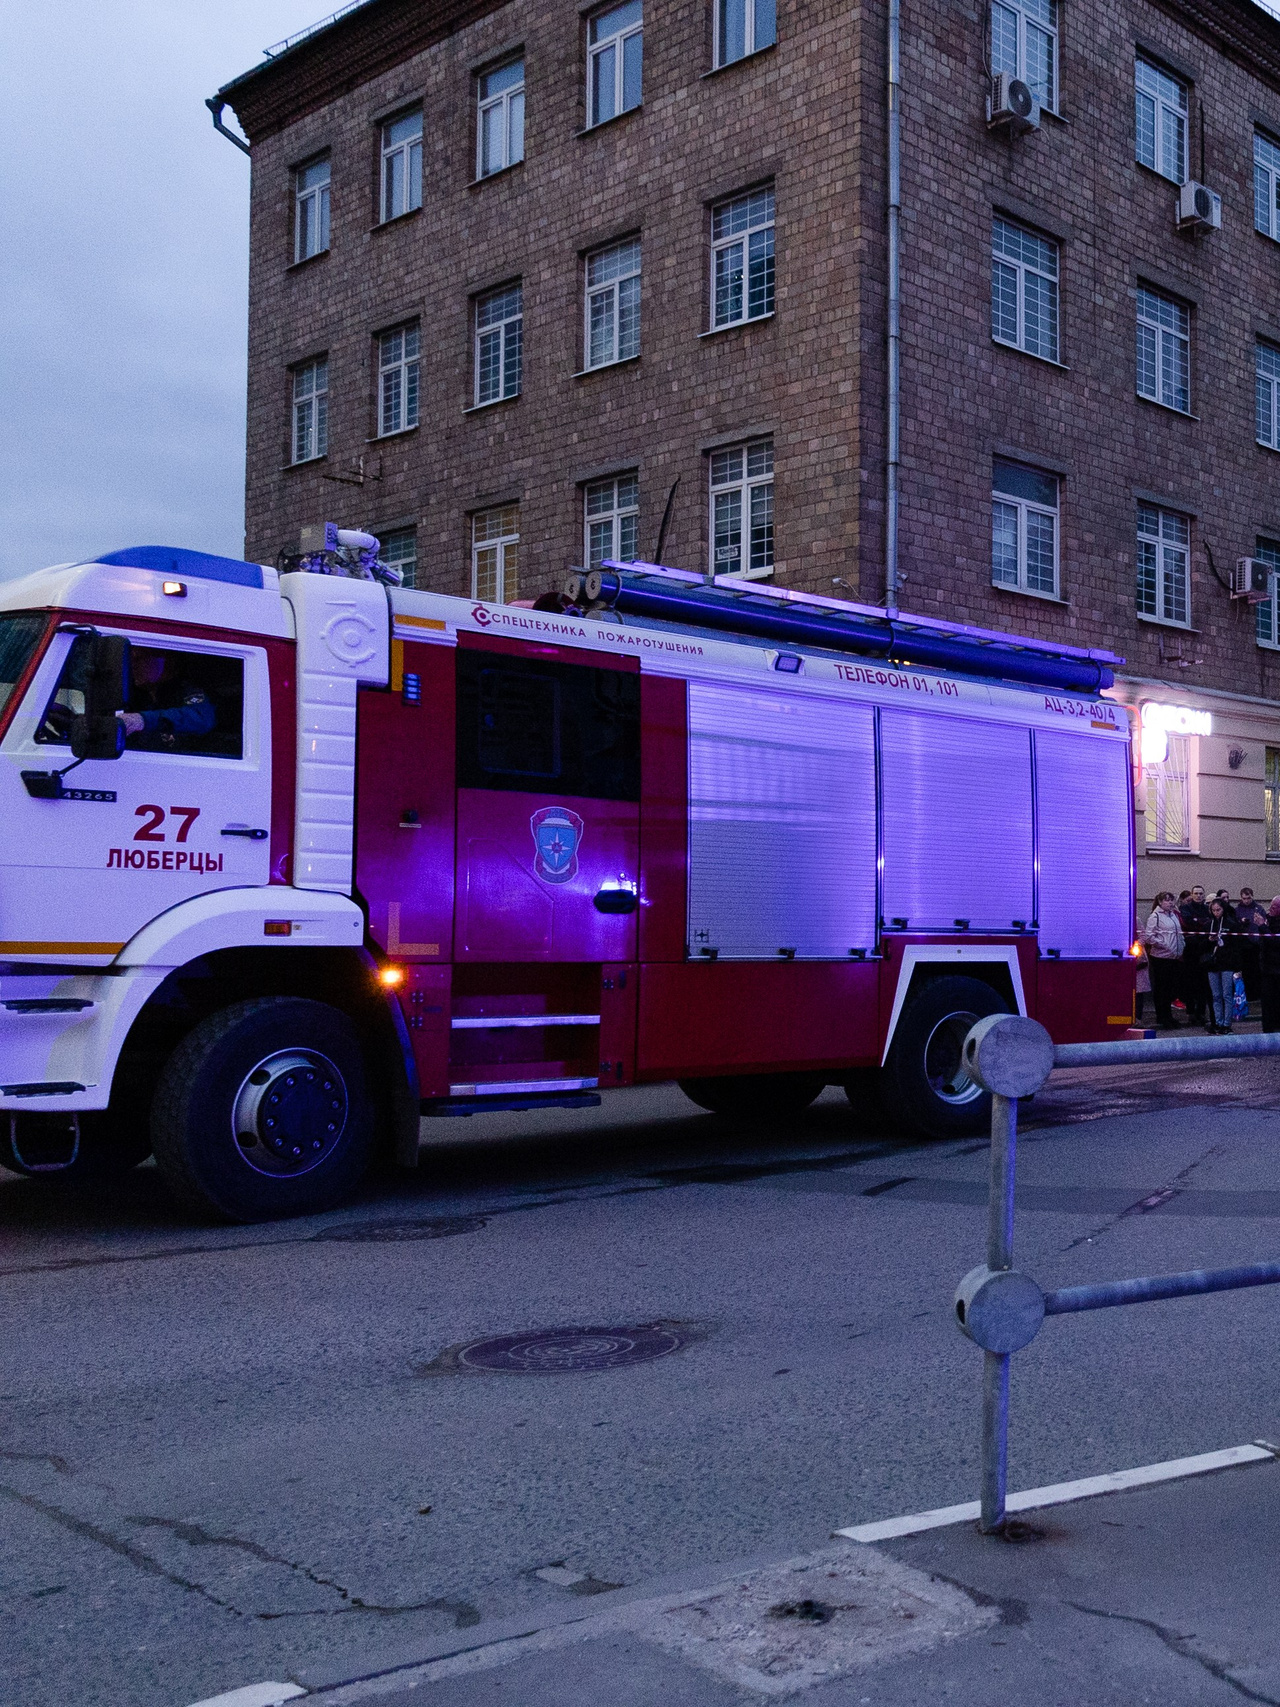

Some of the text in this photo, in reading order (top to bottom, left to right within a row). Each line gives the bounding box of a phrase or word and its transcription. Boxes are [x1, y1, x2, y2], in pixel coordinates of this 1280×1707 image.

[491, 613, 704, 656] СПЕЦТЕХНИКА ПОЖАРОТУШЕНИЯ
[834, 664, 959, 697] ТЕЛЕФОН 01, 101
[1044, 696, 1116, 722] АЦ-3,2-40/4
[63, 791, 114, 801] 43265
[133, 804, 201, 843] 27
[106, 848, 224, 875] ЛЮБЕРЦЫ
